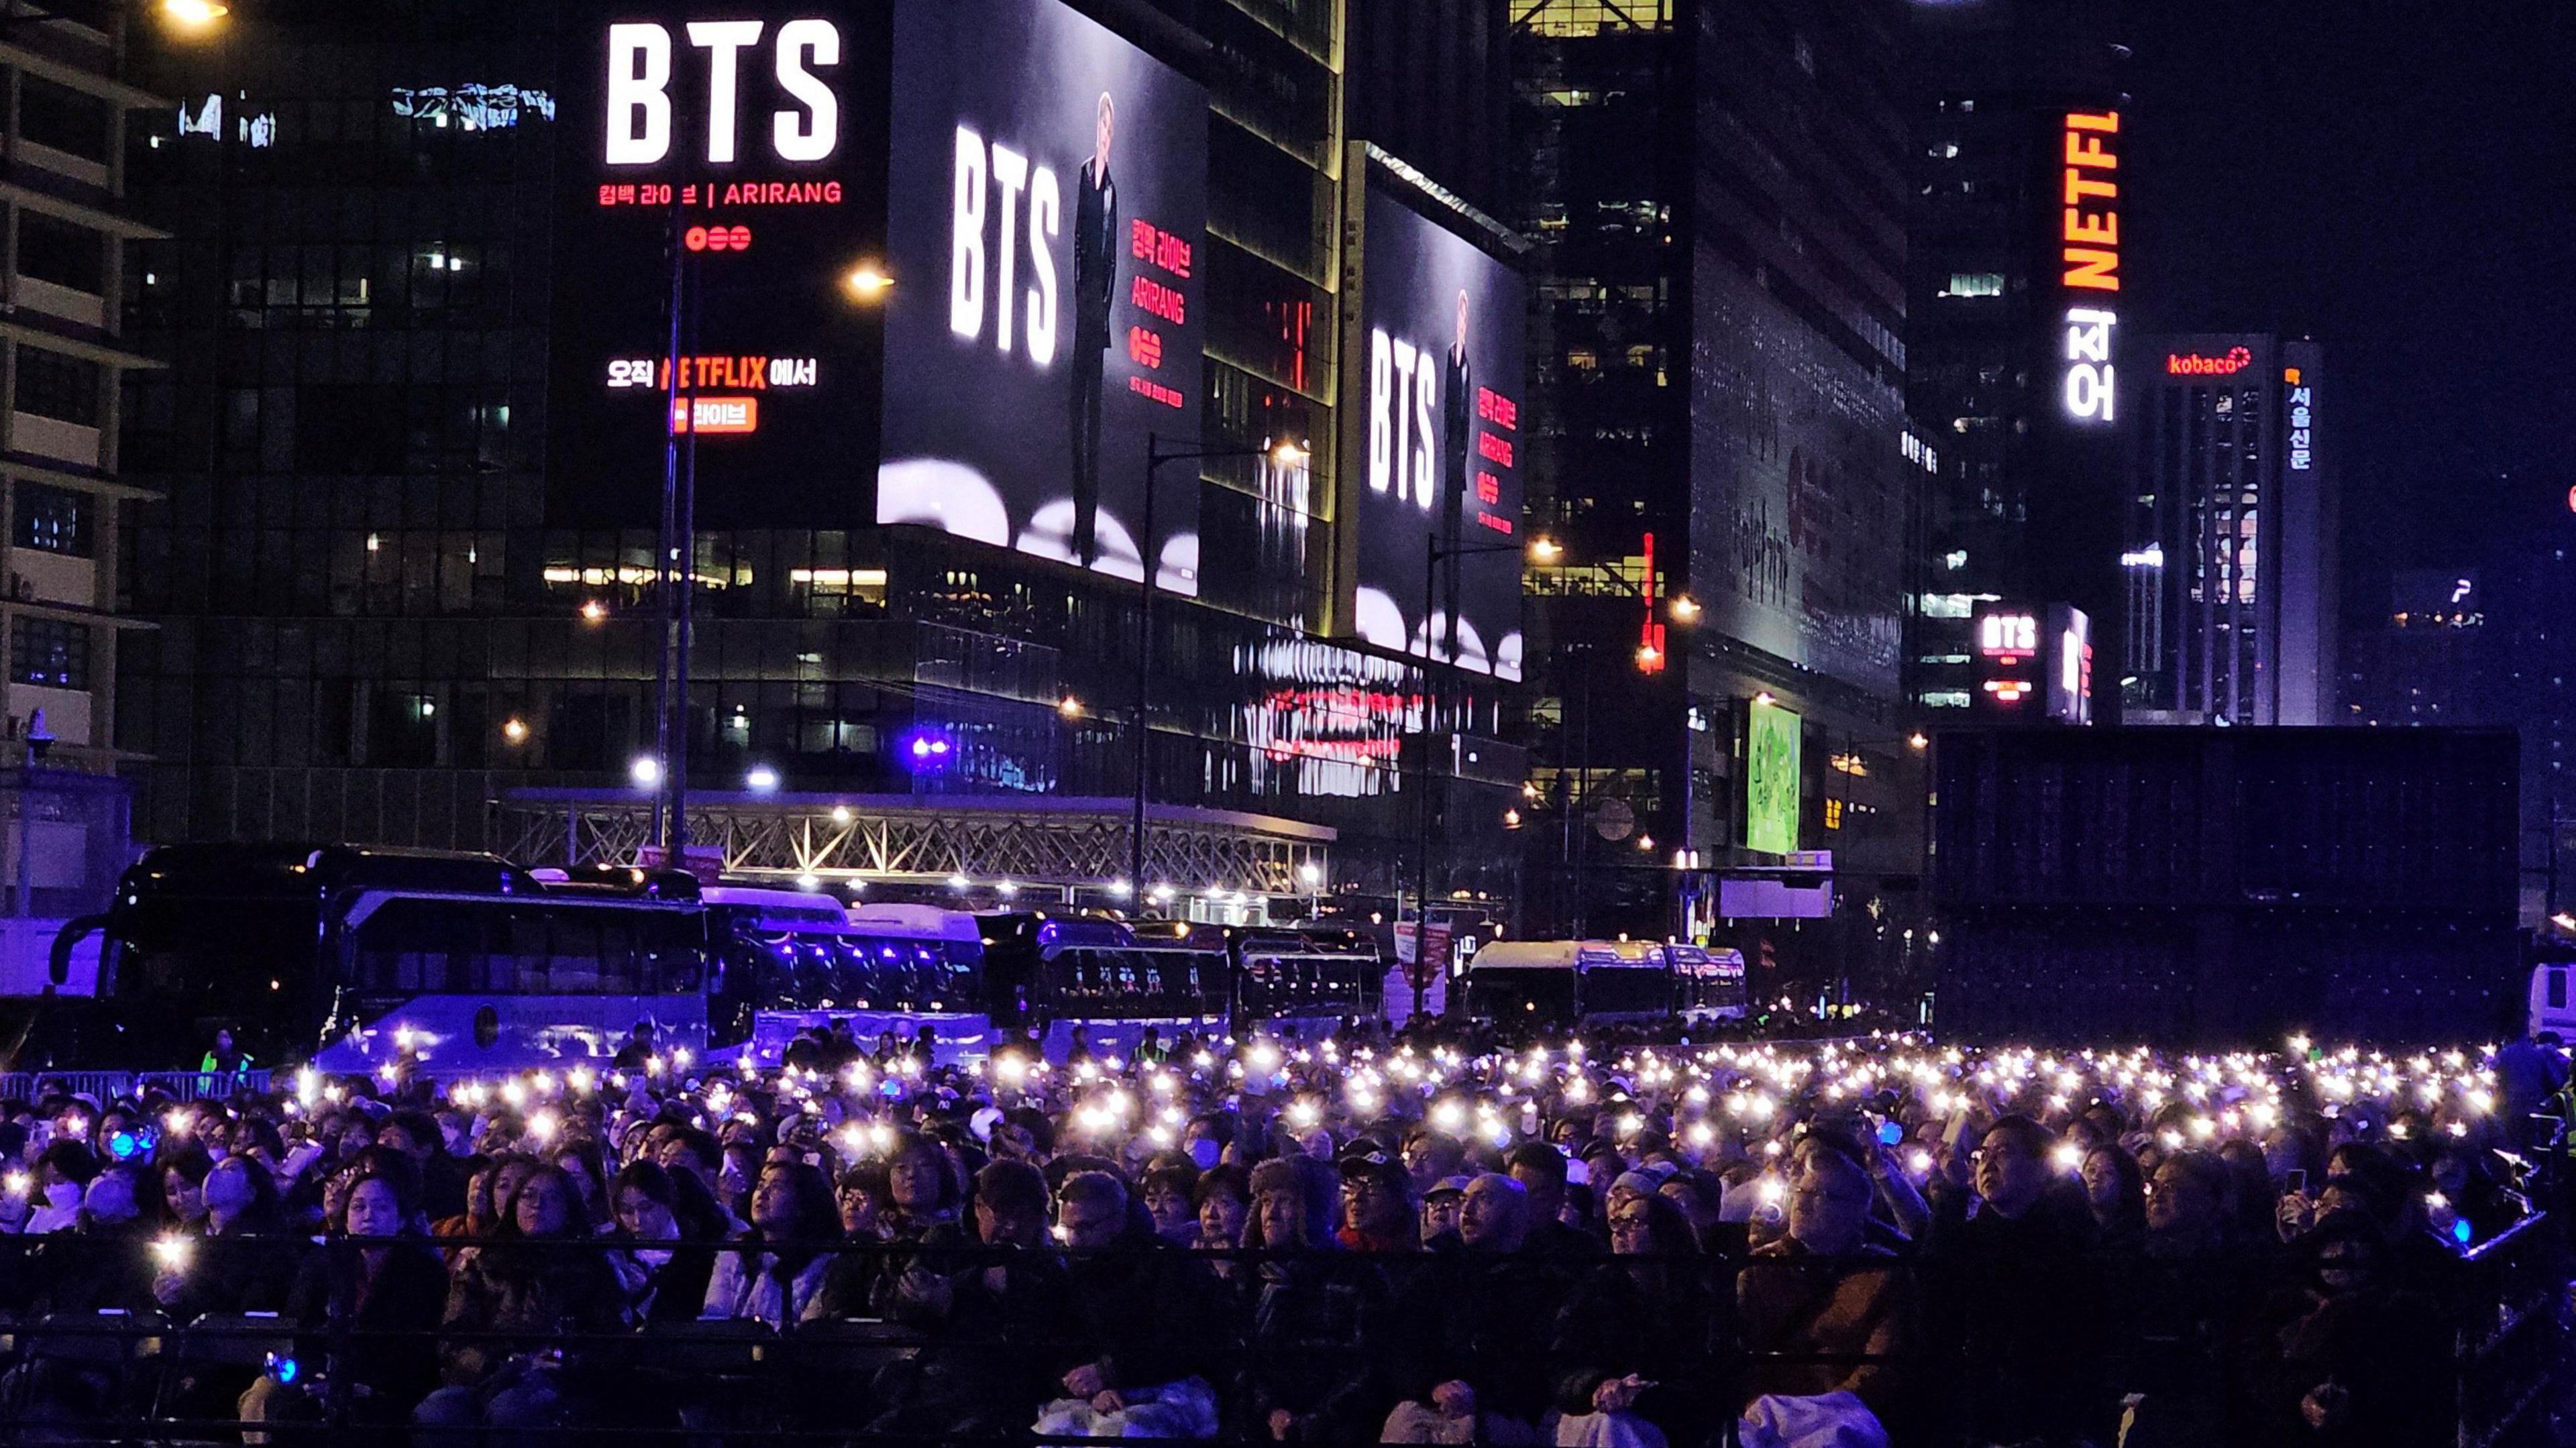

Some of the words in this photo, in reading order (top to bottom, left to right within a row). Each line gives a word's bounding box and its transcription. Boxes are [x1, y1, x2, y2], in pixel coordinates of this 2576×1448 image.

[606, 19, 840, 164] BTS
[600, 184, 635, 205] 컴백
[723, 181, 841, 205] ARIRANG
[951, 124, 1060, 366] BTS
[1157, 231, 1191, 278] 라이브
[1132, 275, 1185, 325] ARIRANG
[607, 359, 654, 388] 오직
[2168, 353, 2237, 374] kobaco
[694, 403, 747, 425] 라이브
[1369, 327, 1436, 510] BTS
[2289, 387, 2311, 469] 서울신문
